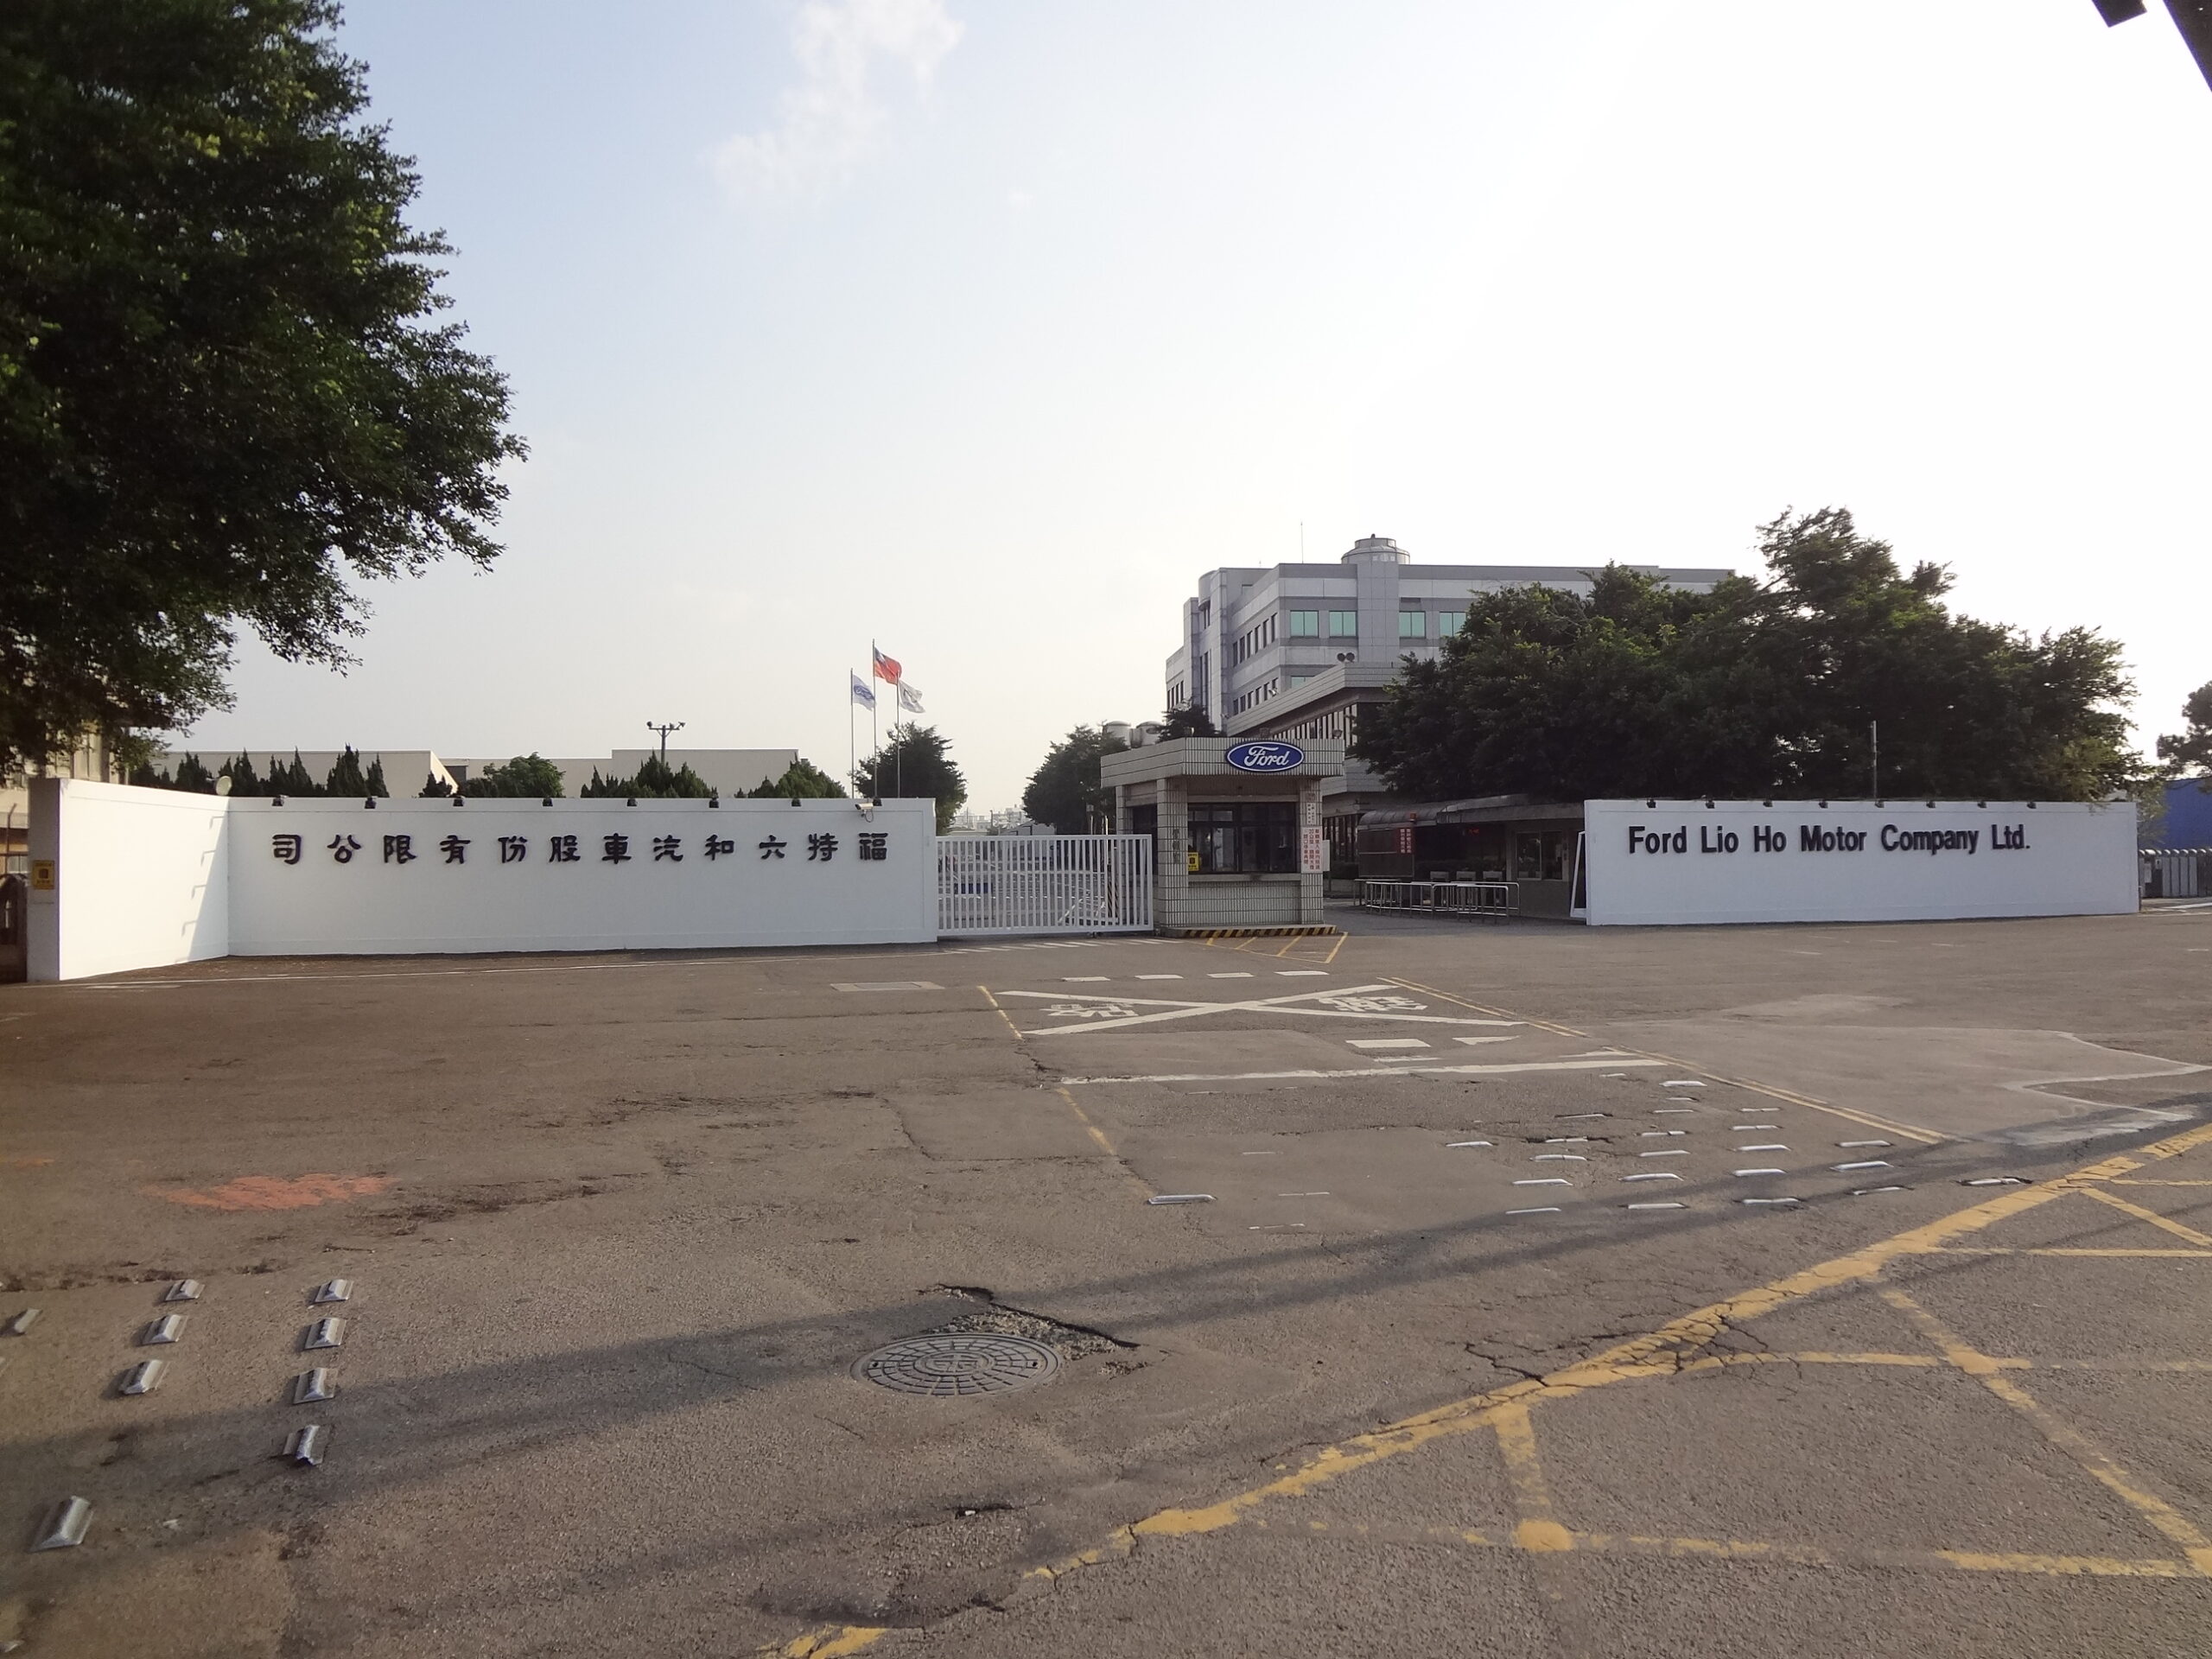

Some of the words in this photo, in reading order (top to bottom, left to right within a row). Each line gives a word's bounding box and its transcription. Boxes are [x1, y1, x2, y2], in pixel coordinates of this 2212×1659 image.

[1243, 745, 1290, 766] Ford
[1628, 825, 1688, 855] Ford
[1700, 825, 1739, 854] Lio
[1753, 825, 1787, 853] Ho
[1800, 824, 1868, 853] Motor
[1880, 823, 1980, 856] Company
[1991, 823, 2031, 850] Ltd.
